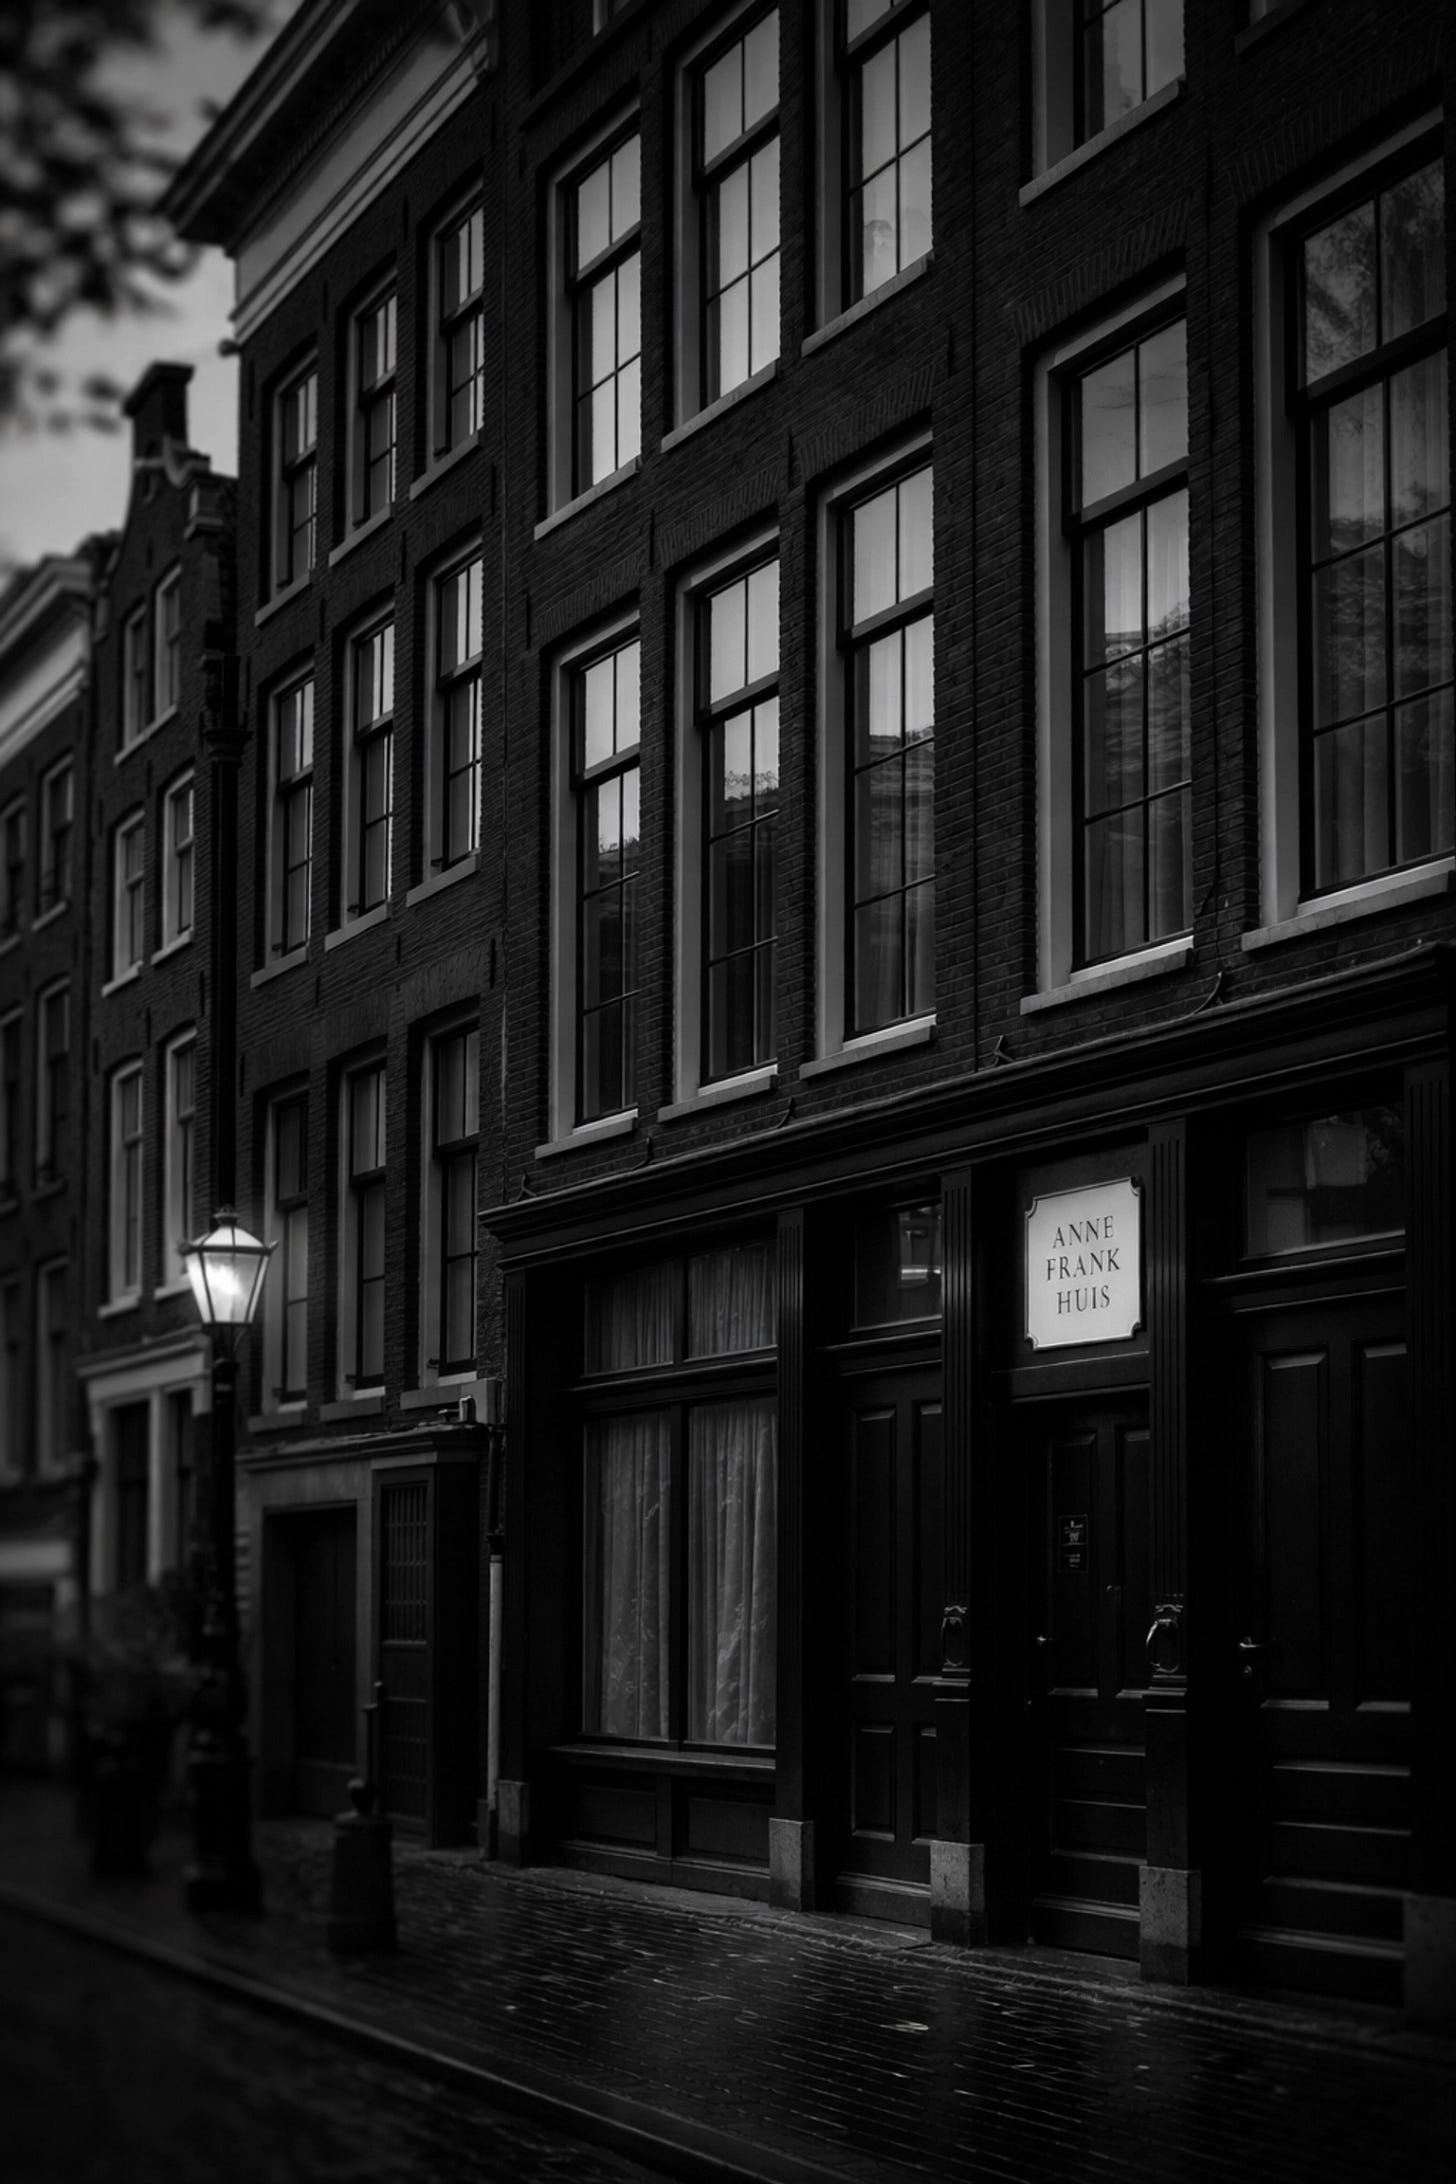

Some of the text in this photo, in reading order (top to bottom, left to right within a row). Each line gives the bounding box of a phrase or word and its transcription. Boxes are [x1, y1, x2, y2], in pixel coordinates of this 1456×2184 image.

[1052, 1215, 1114, 1249] ANNE
[1046, 1248, 1121, 1282] FRANK
[1056, 1285, 1111, 1315] HUIS
